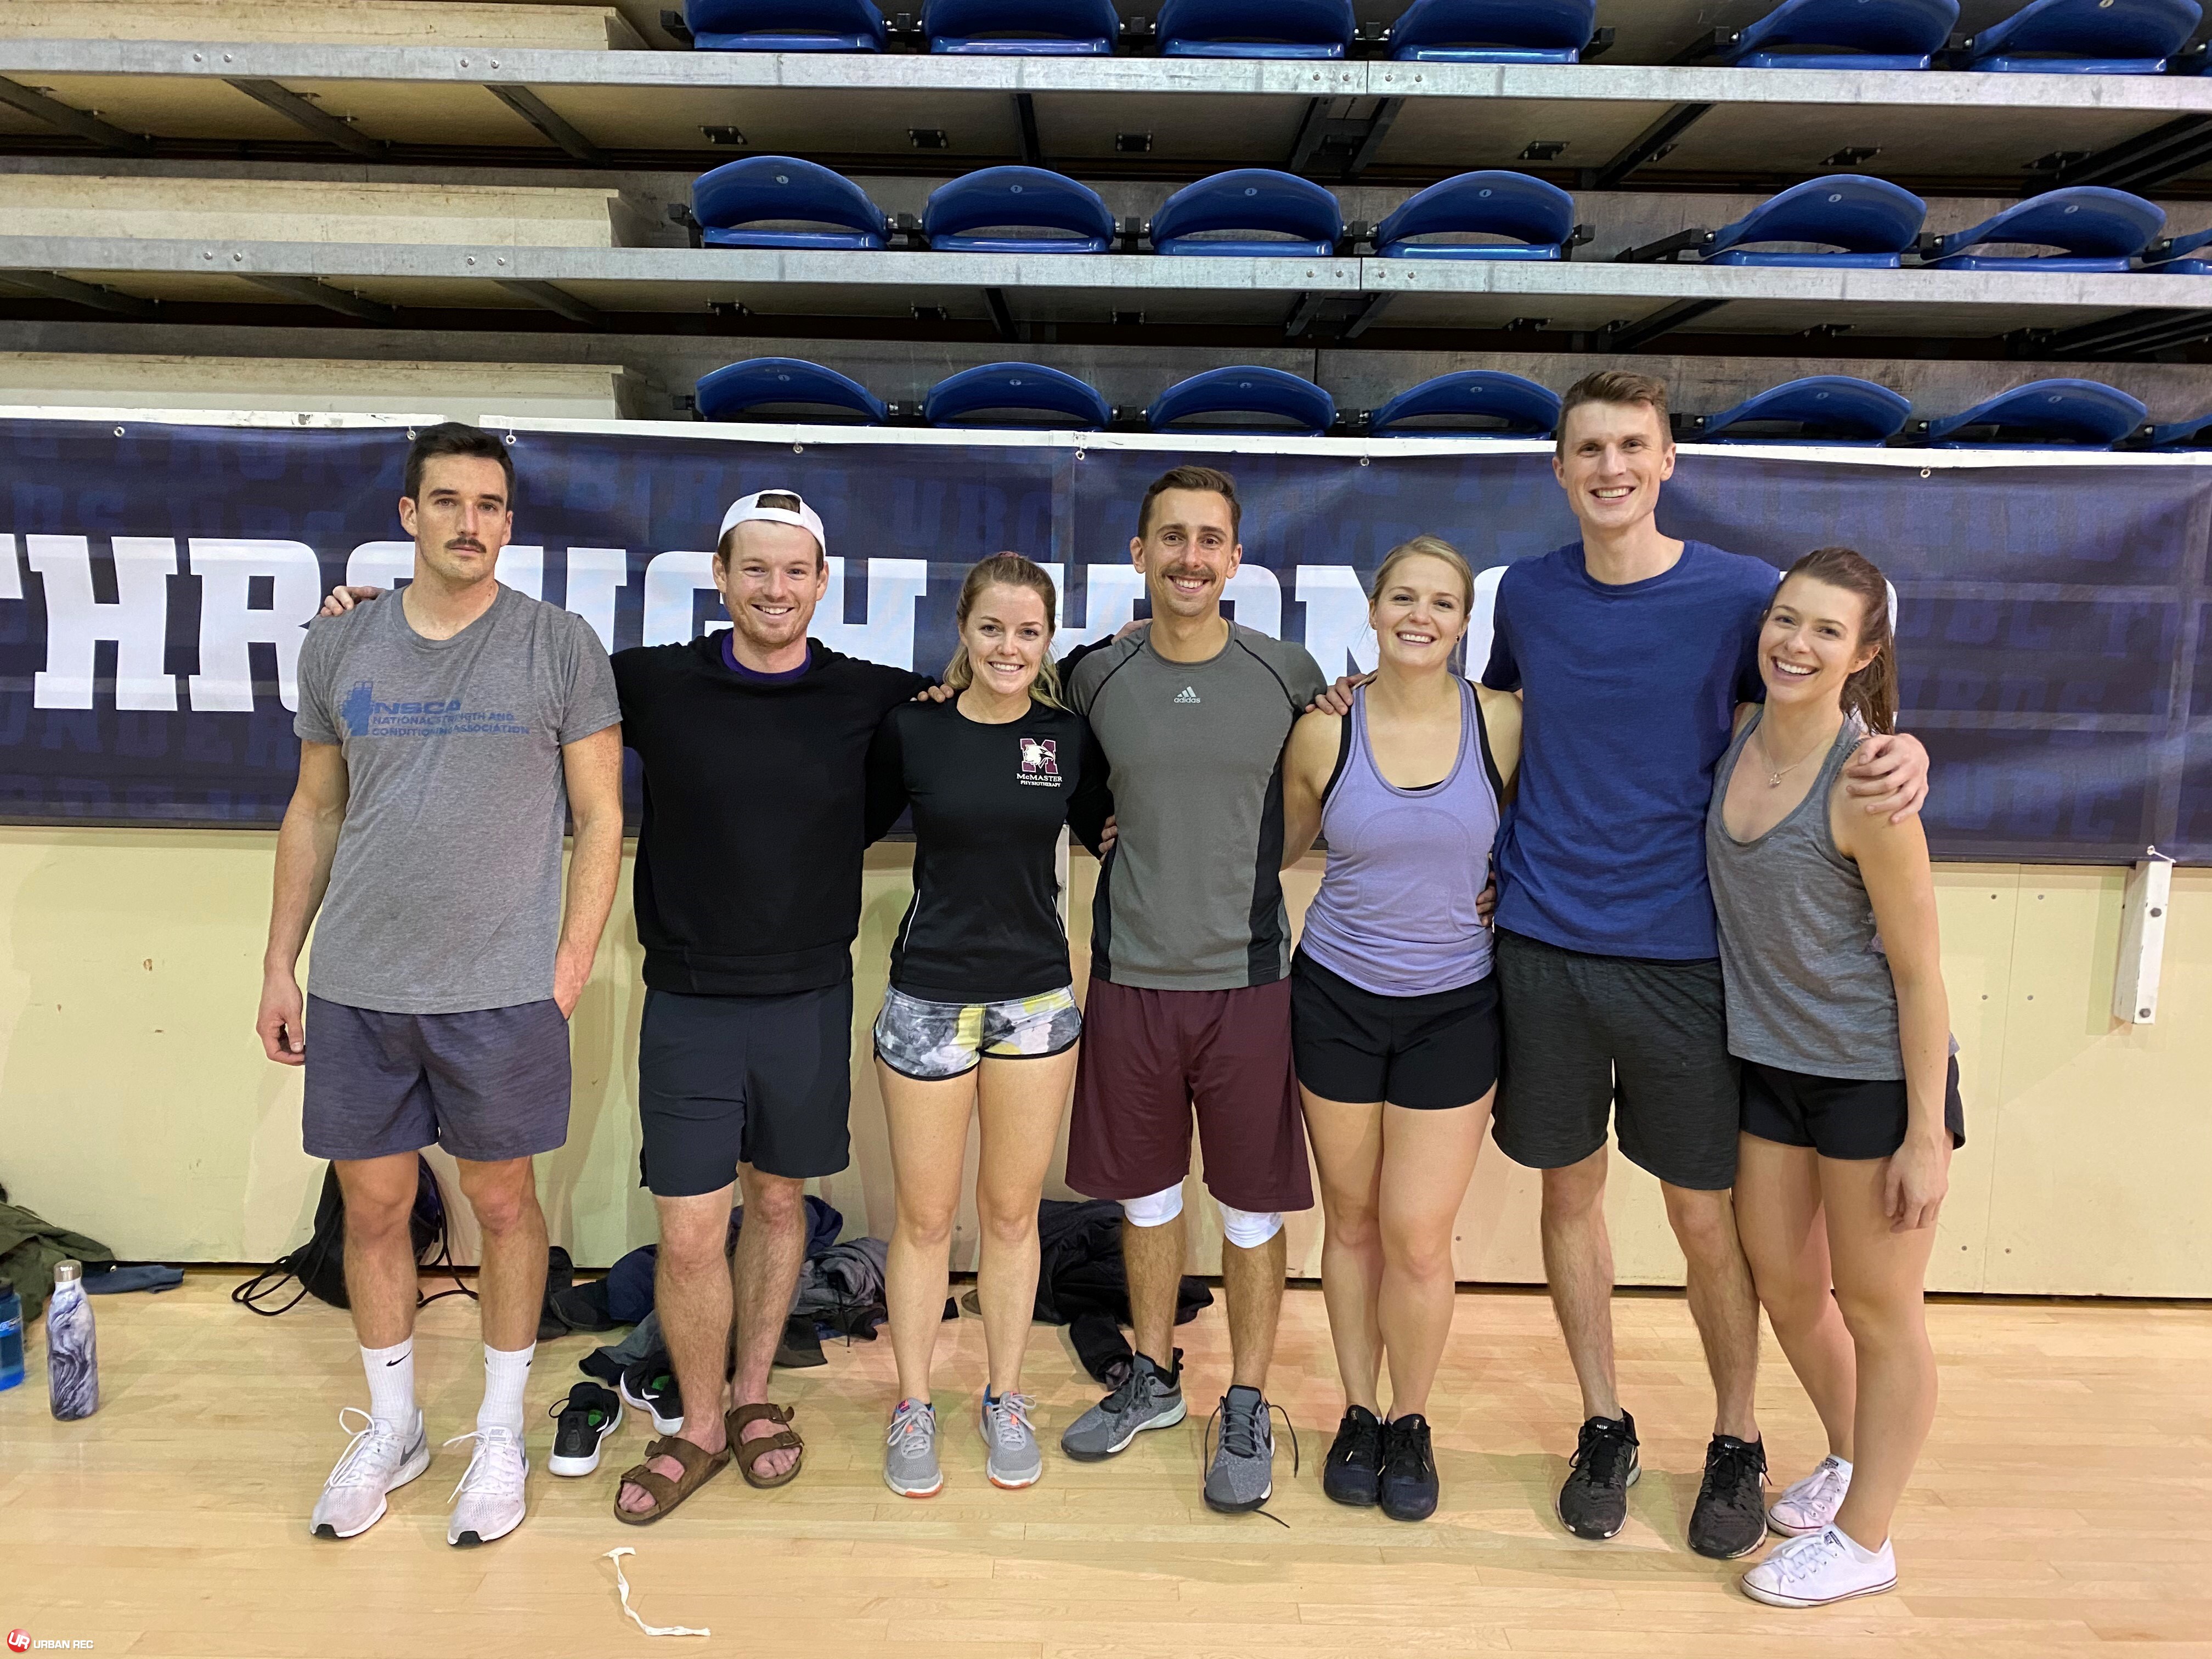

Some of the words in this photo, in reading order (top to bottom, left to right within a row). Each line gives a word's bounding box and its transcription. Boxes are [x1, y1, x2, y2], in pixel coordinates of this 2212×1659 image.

[0, 533, 927, 713] HRGH
[373, 699, 461, 714] NSCA
[373, 715, 433, 725] NATIONAL
[1016, 773, 1063, 782] McMASTER
